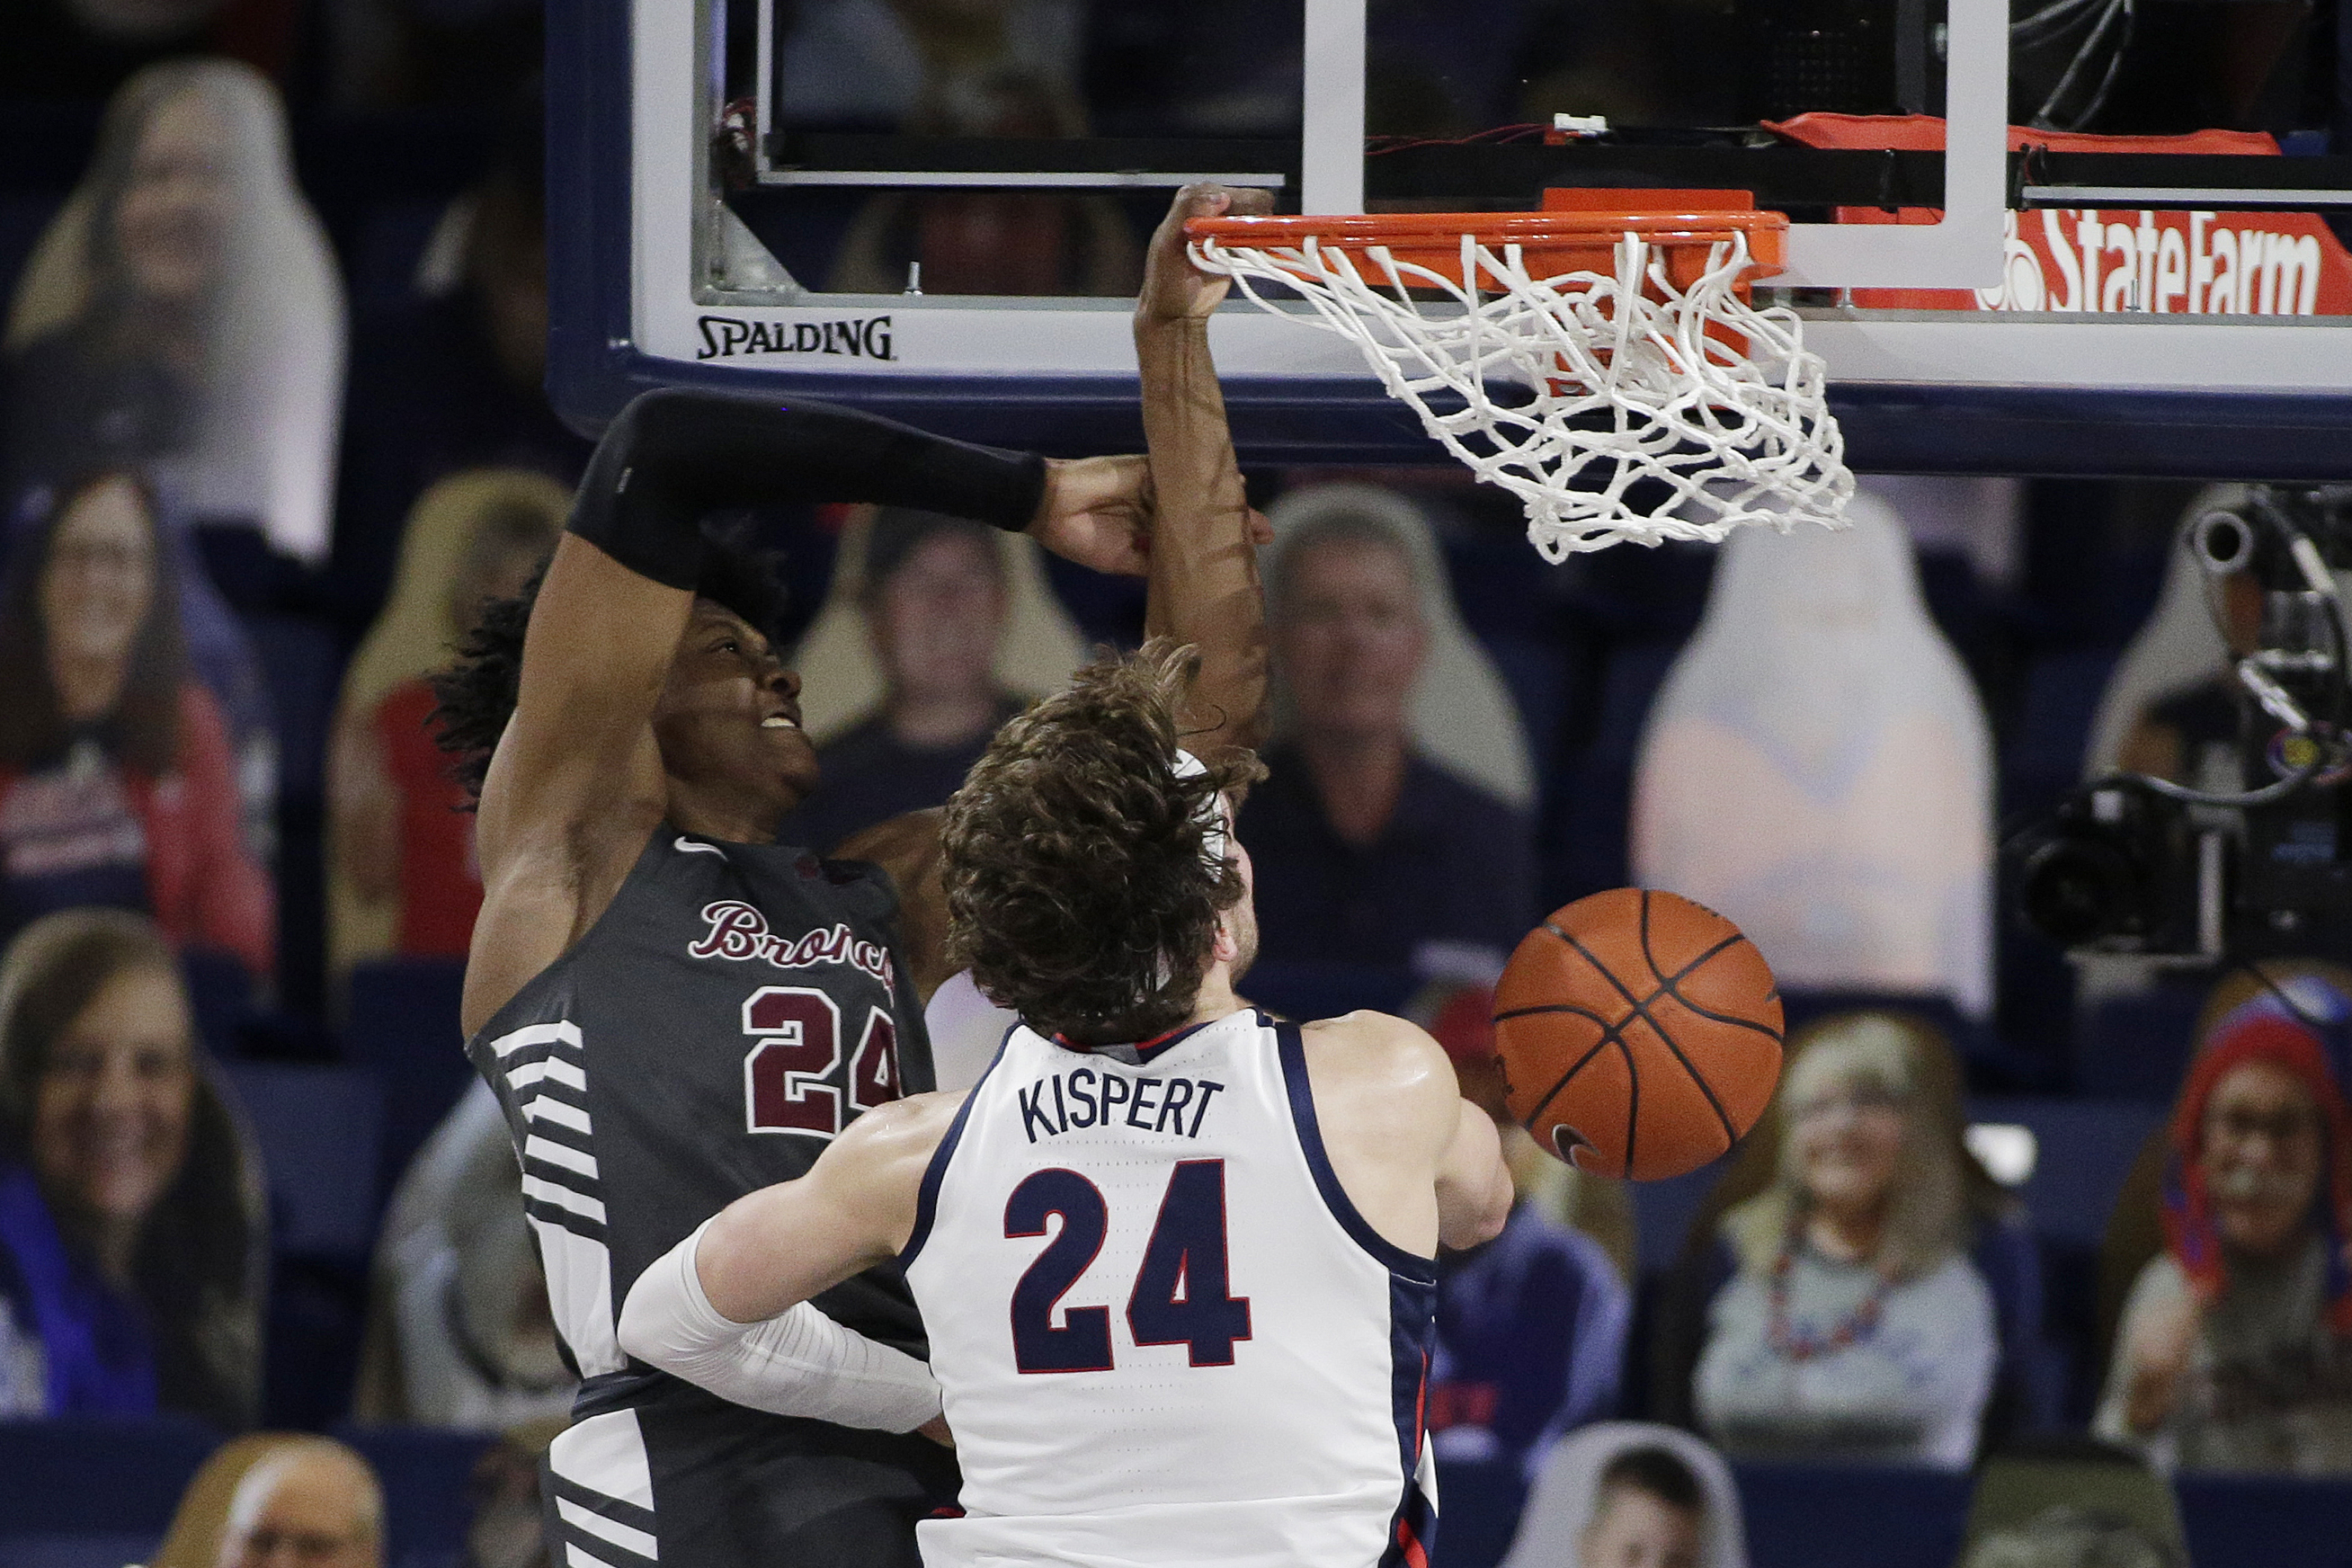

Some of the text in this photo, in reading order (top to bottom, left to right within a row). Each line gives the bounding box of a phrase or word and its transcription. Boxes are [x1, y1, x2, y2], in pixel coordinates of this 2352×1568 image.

[697, 316, 893, 361] SPALDING
[742, 986, 904, 1139] 24
[1018, 1067, 1225, 1144] KISPERT
[1003, 1158, 1252, 1374] 24
